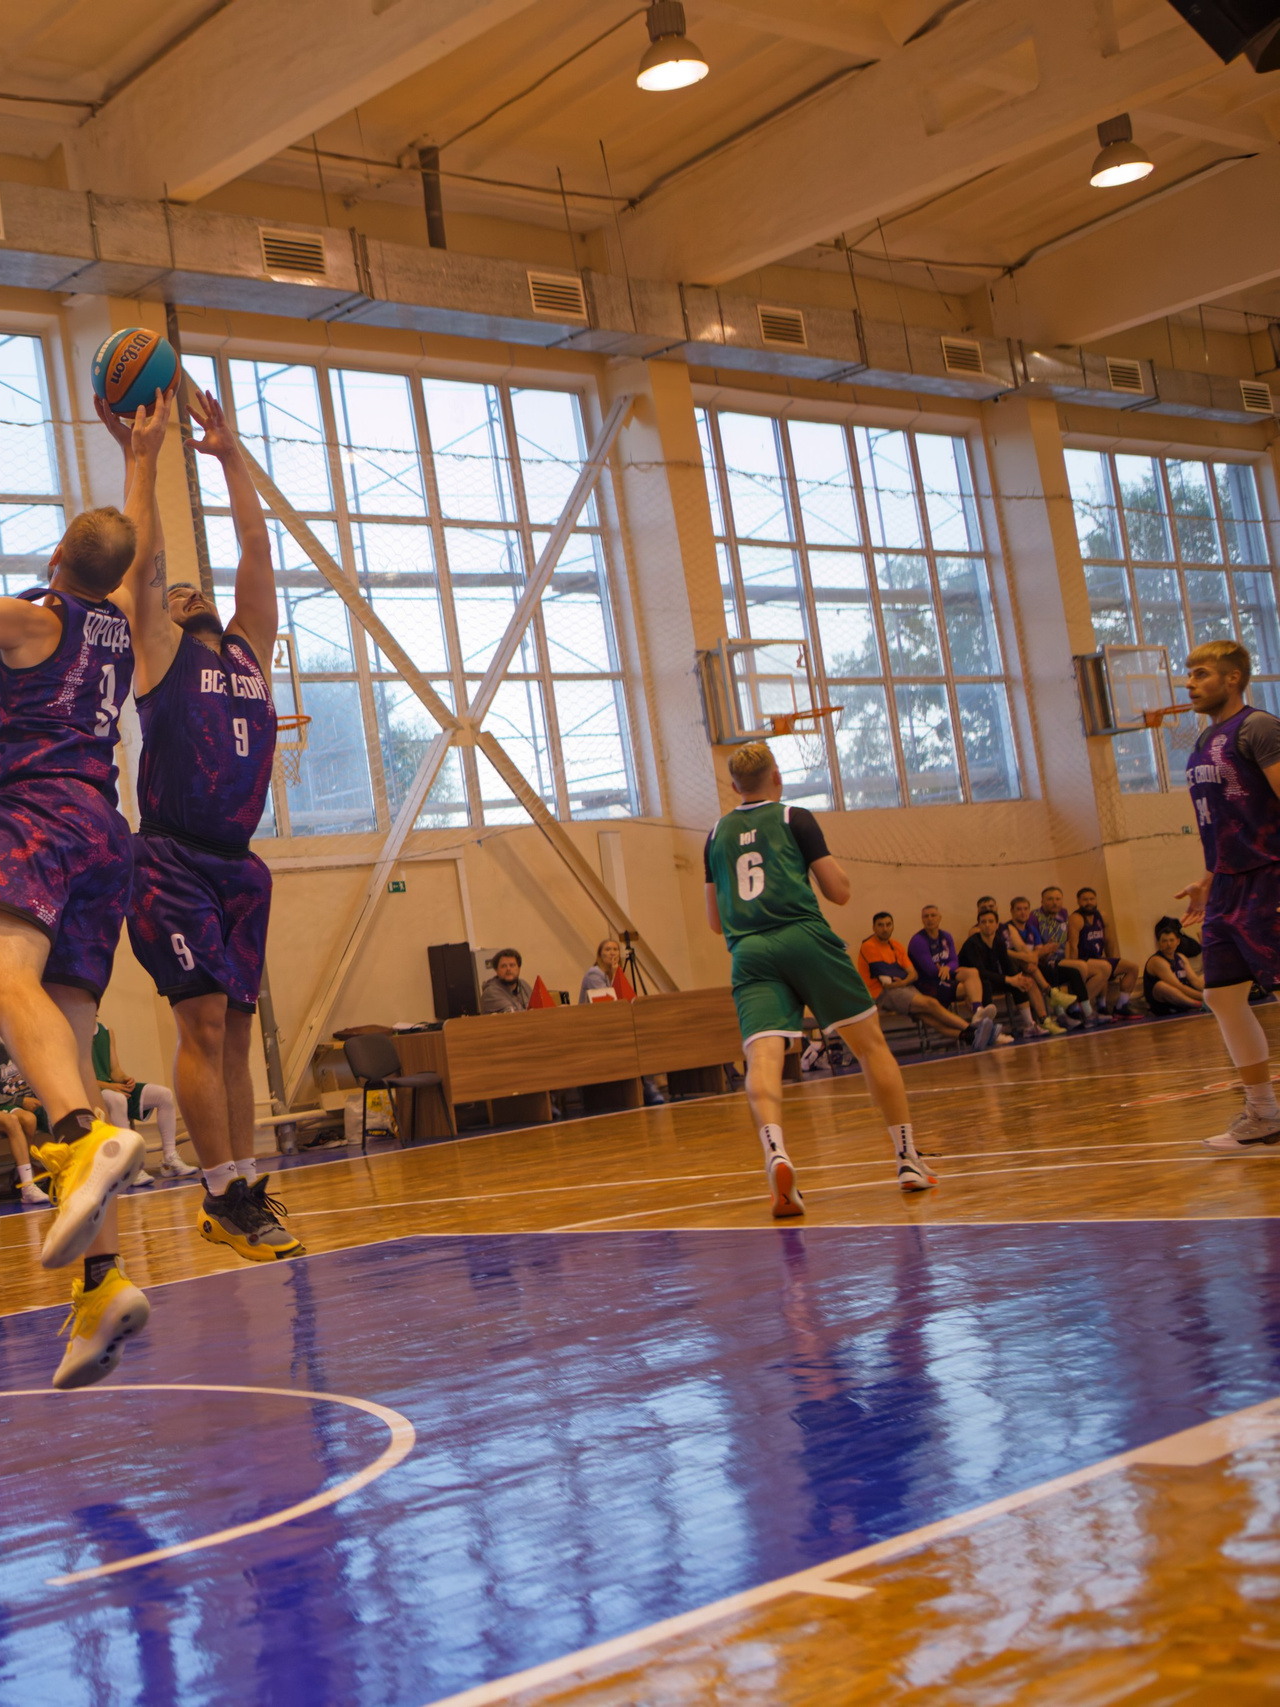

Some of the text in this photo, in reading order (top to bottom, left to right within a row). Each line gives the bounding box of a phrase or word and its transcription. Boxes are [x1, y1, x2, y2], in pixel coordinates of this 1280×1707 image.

[111, 333, 153, 384] Wilson
[233, 718, 249, 757] 9
[736, 851, 765, 901] 6
[170, 933, 195, 971] 9
